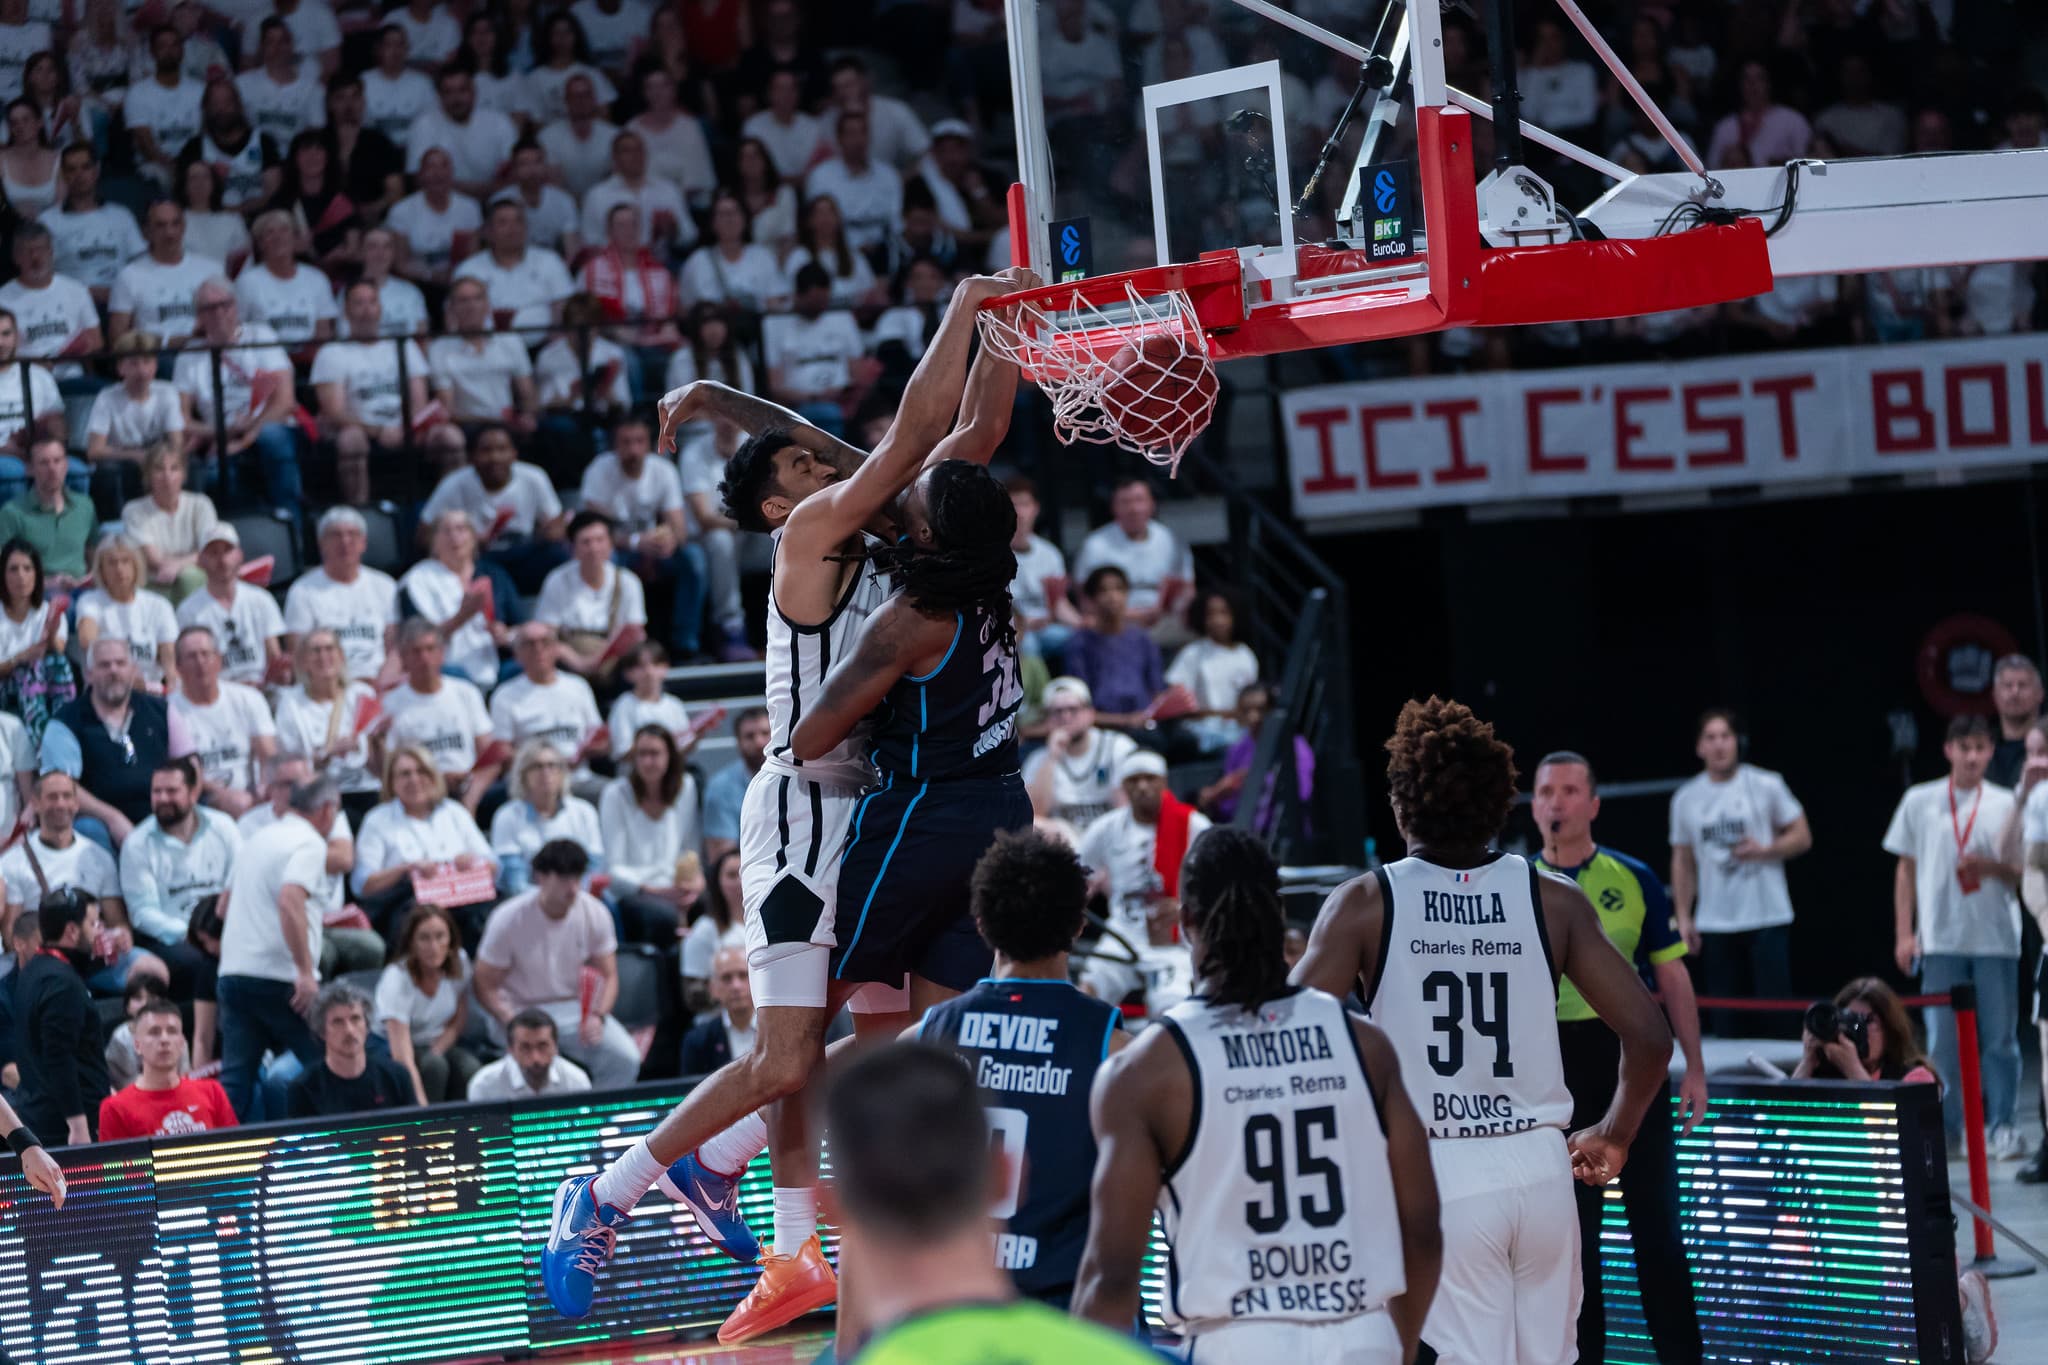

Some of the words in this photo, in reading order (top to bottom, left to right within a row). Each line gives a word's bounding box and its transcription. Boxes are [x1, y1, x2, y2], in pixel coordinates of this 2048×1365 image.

[1374, 219, 1401, 237] BKT
[1373, 241, 1406, 256] EuroCup
[1296, 397, 1488, 495] ICI
[1524, 374, 1815, 474] C'EST
[1423, 890, 1507, 925] KOKILA
[1410, 939, 1466, 955] Charles
[1472, 938, 1522, 956] Réma
[958, 1012, 1059, 1053] DEVOE
[1422, 971, 1514, 1078] 34
[1221, 1025, 1333, 1069] MOKOKA
[976, 1055, 1072, 1095] Gamador
[1433, 1092, 1513, 1121] BOURG
[1244, 1105, 1346, 1235] 95
[1248, 1240, 1351, 1281] BOURG
[1230, 1287, 1270, 1317] EN
[1277, 1278, 1367, 1313] BRESSE
